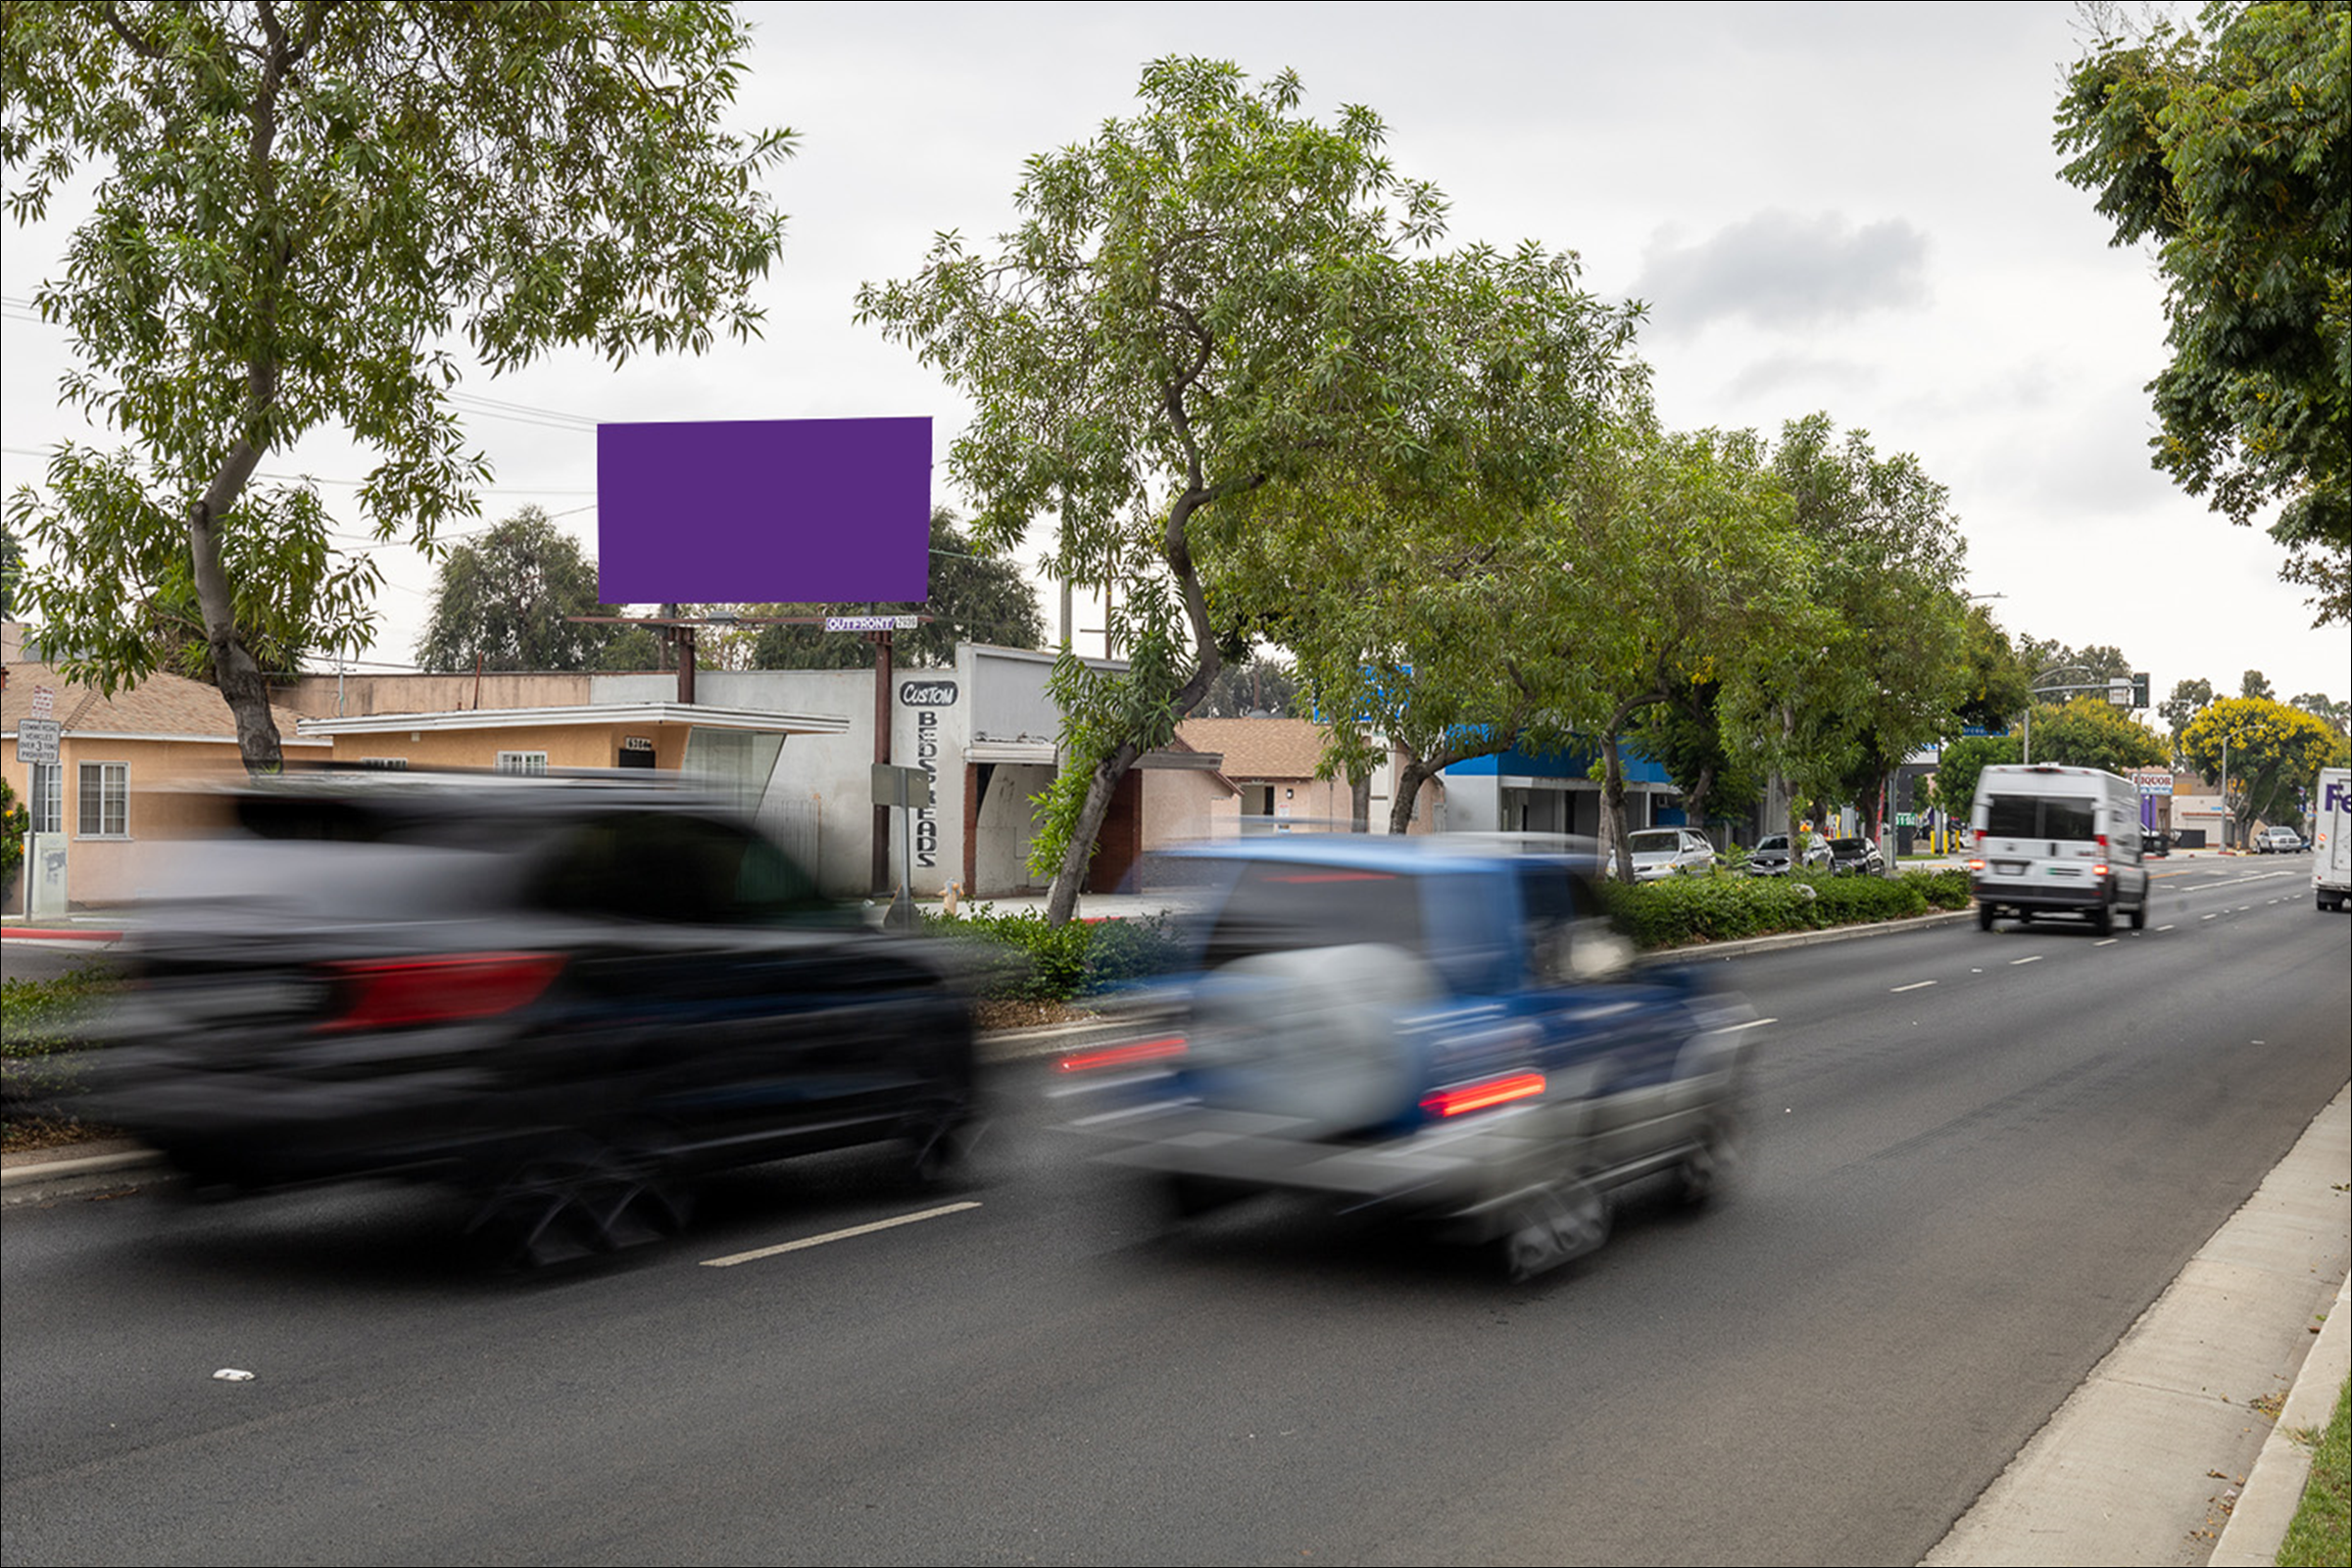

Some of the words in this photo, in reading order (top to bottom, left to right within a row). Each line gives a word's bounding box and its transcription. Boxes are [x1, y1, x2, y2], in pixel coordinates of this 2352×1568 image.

[828, 617, 893, 629] OUTFRONT
[22, 723, 57, 733] COMMERCIAL
[25, 733, 53, 742] VEHICLES
[35, 740, 42, 752] 3
[22, 751, 55, 760] PROHIBITED
